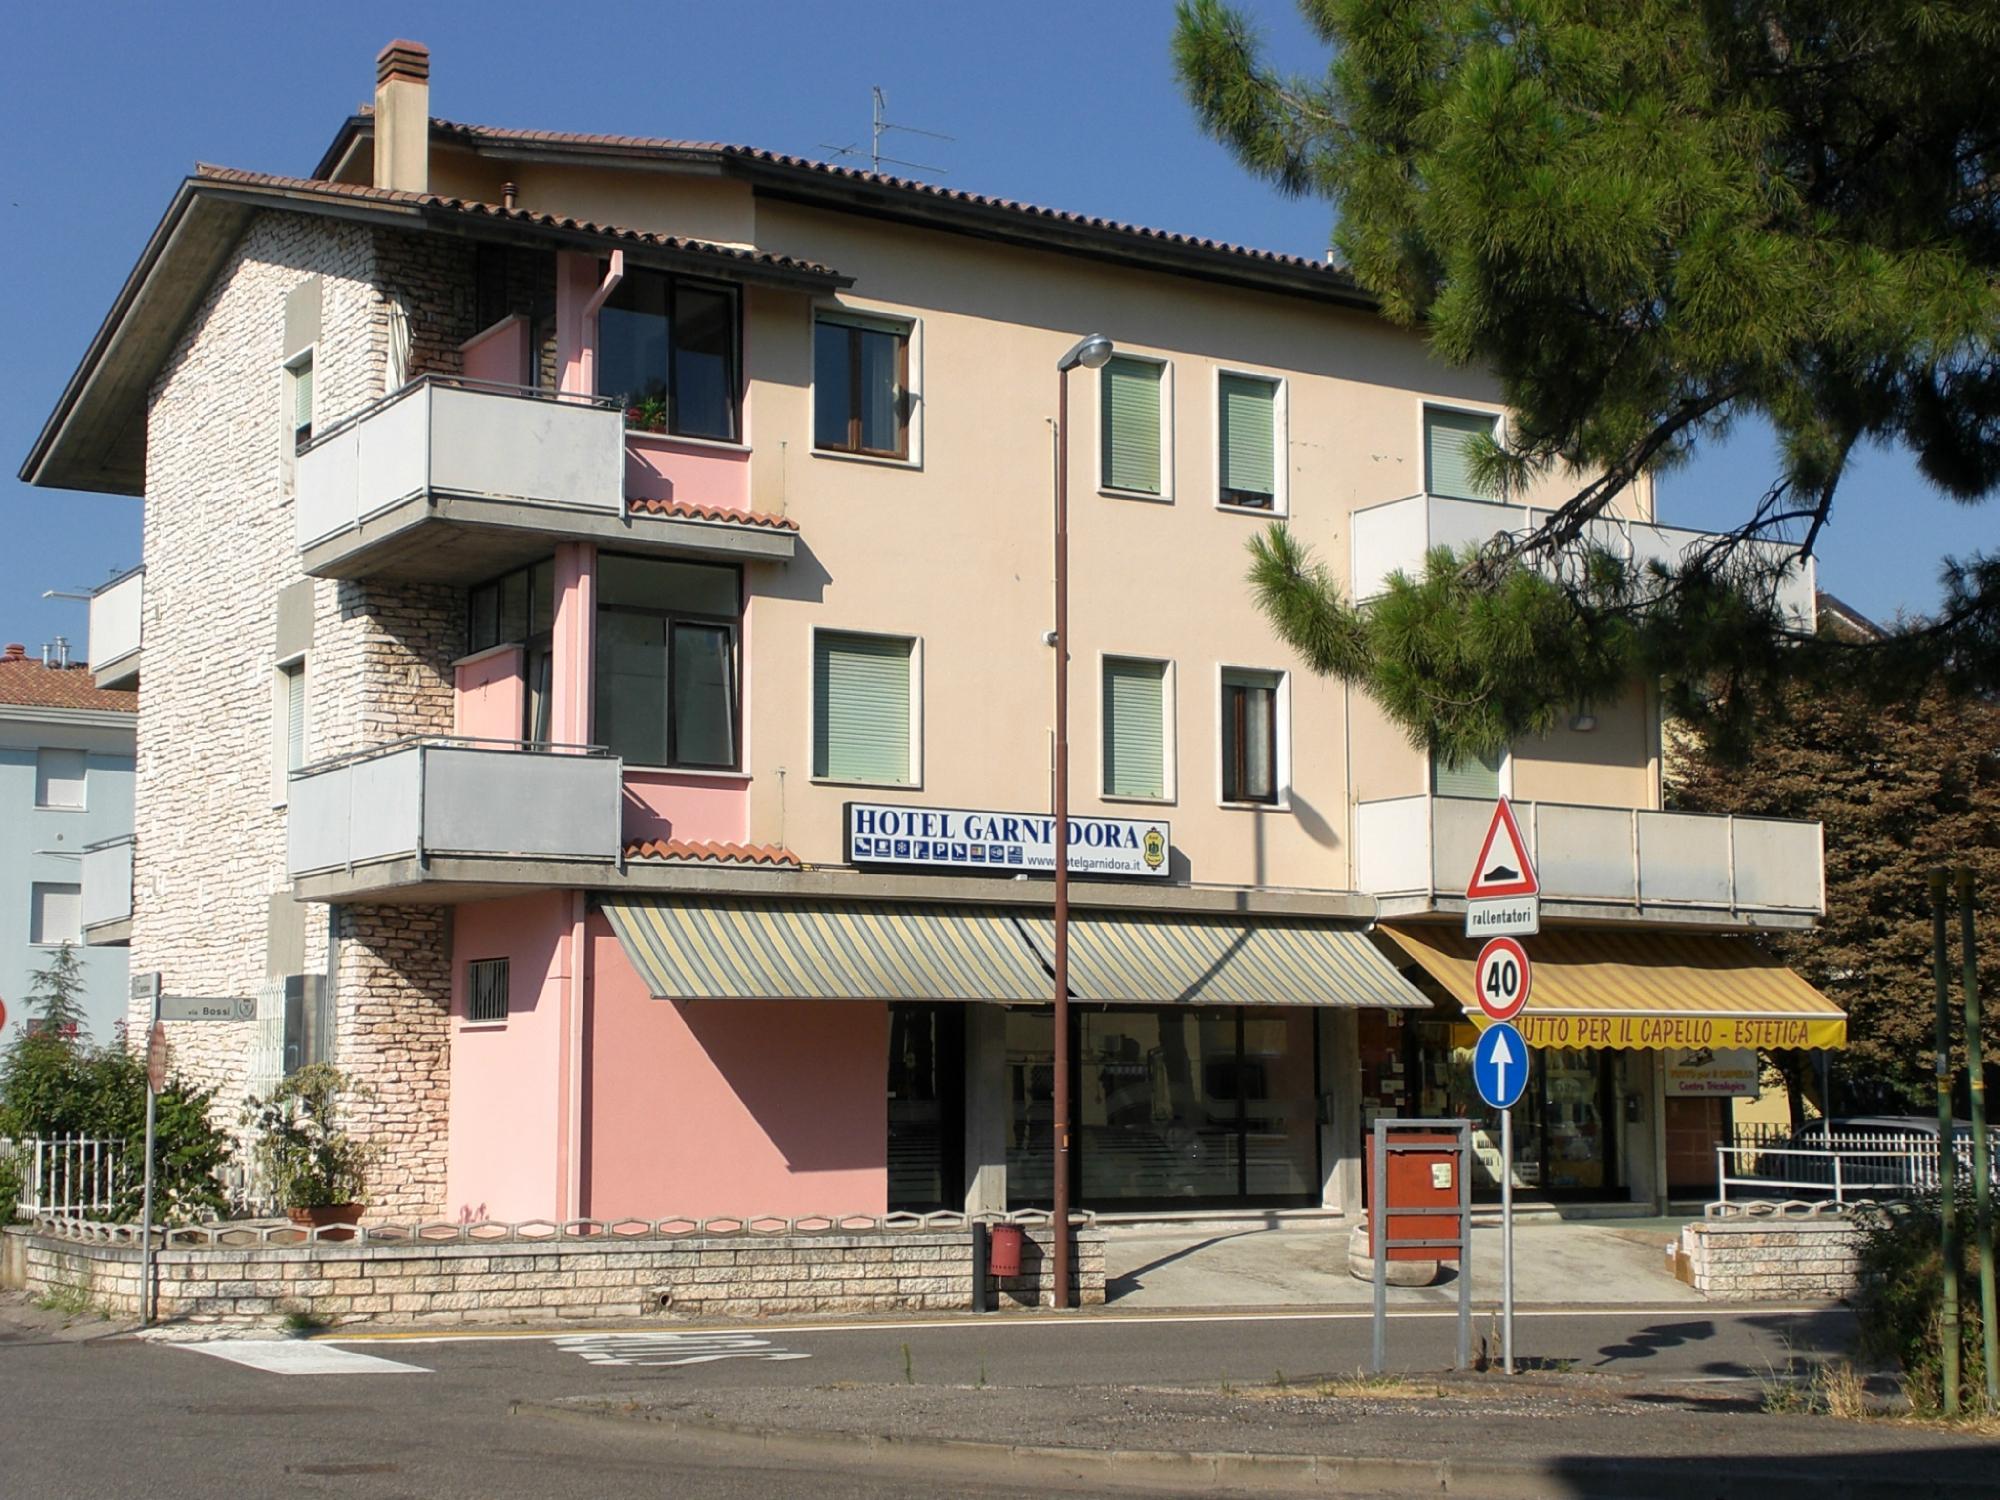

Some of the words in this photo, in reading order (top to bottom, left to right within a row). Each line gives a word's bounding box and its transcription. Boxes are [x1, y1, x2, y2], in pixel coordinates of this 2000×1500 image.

[855, 809, 956, 839] HOTEL
[1066, 821, 1140, 849] DORA
[1472, 906, 1531, 925] rallentatori
[1486, 959, 1518, 998] 40
[203, 1006, 230, 1016] Bossi
[1577, 1017, 1612, 1044] PER
[1619, 1018, 1633, 1042] IL
[1640, 1018, 1713, 1044] CAPELLO
[1734, 1020, 1809, 1045] ESTETICA
